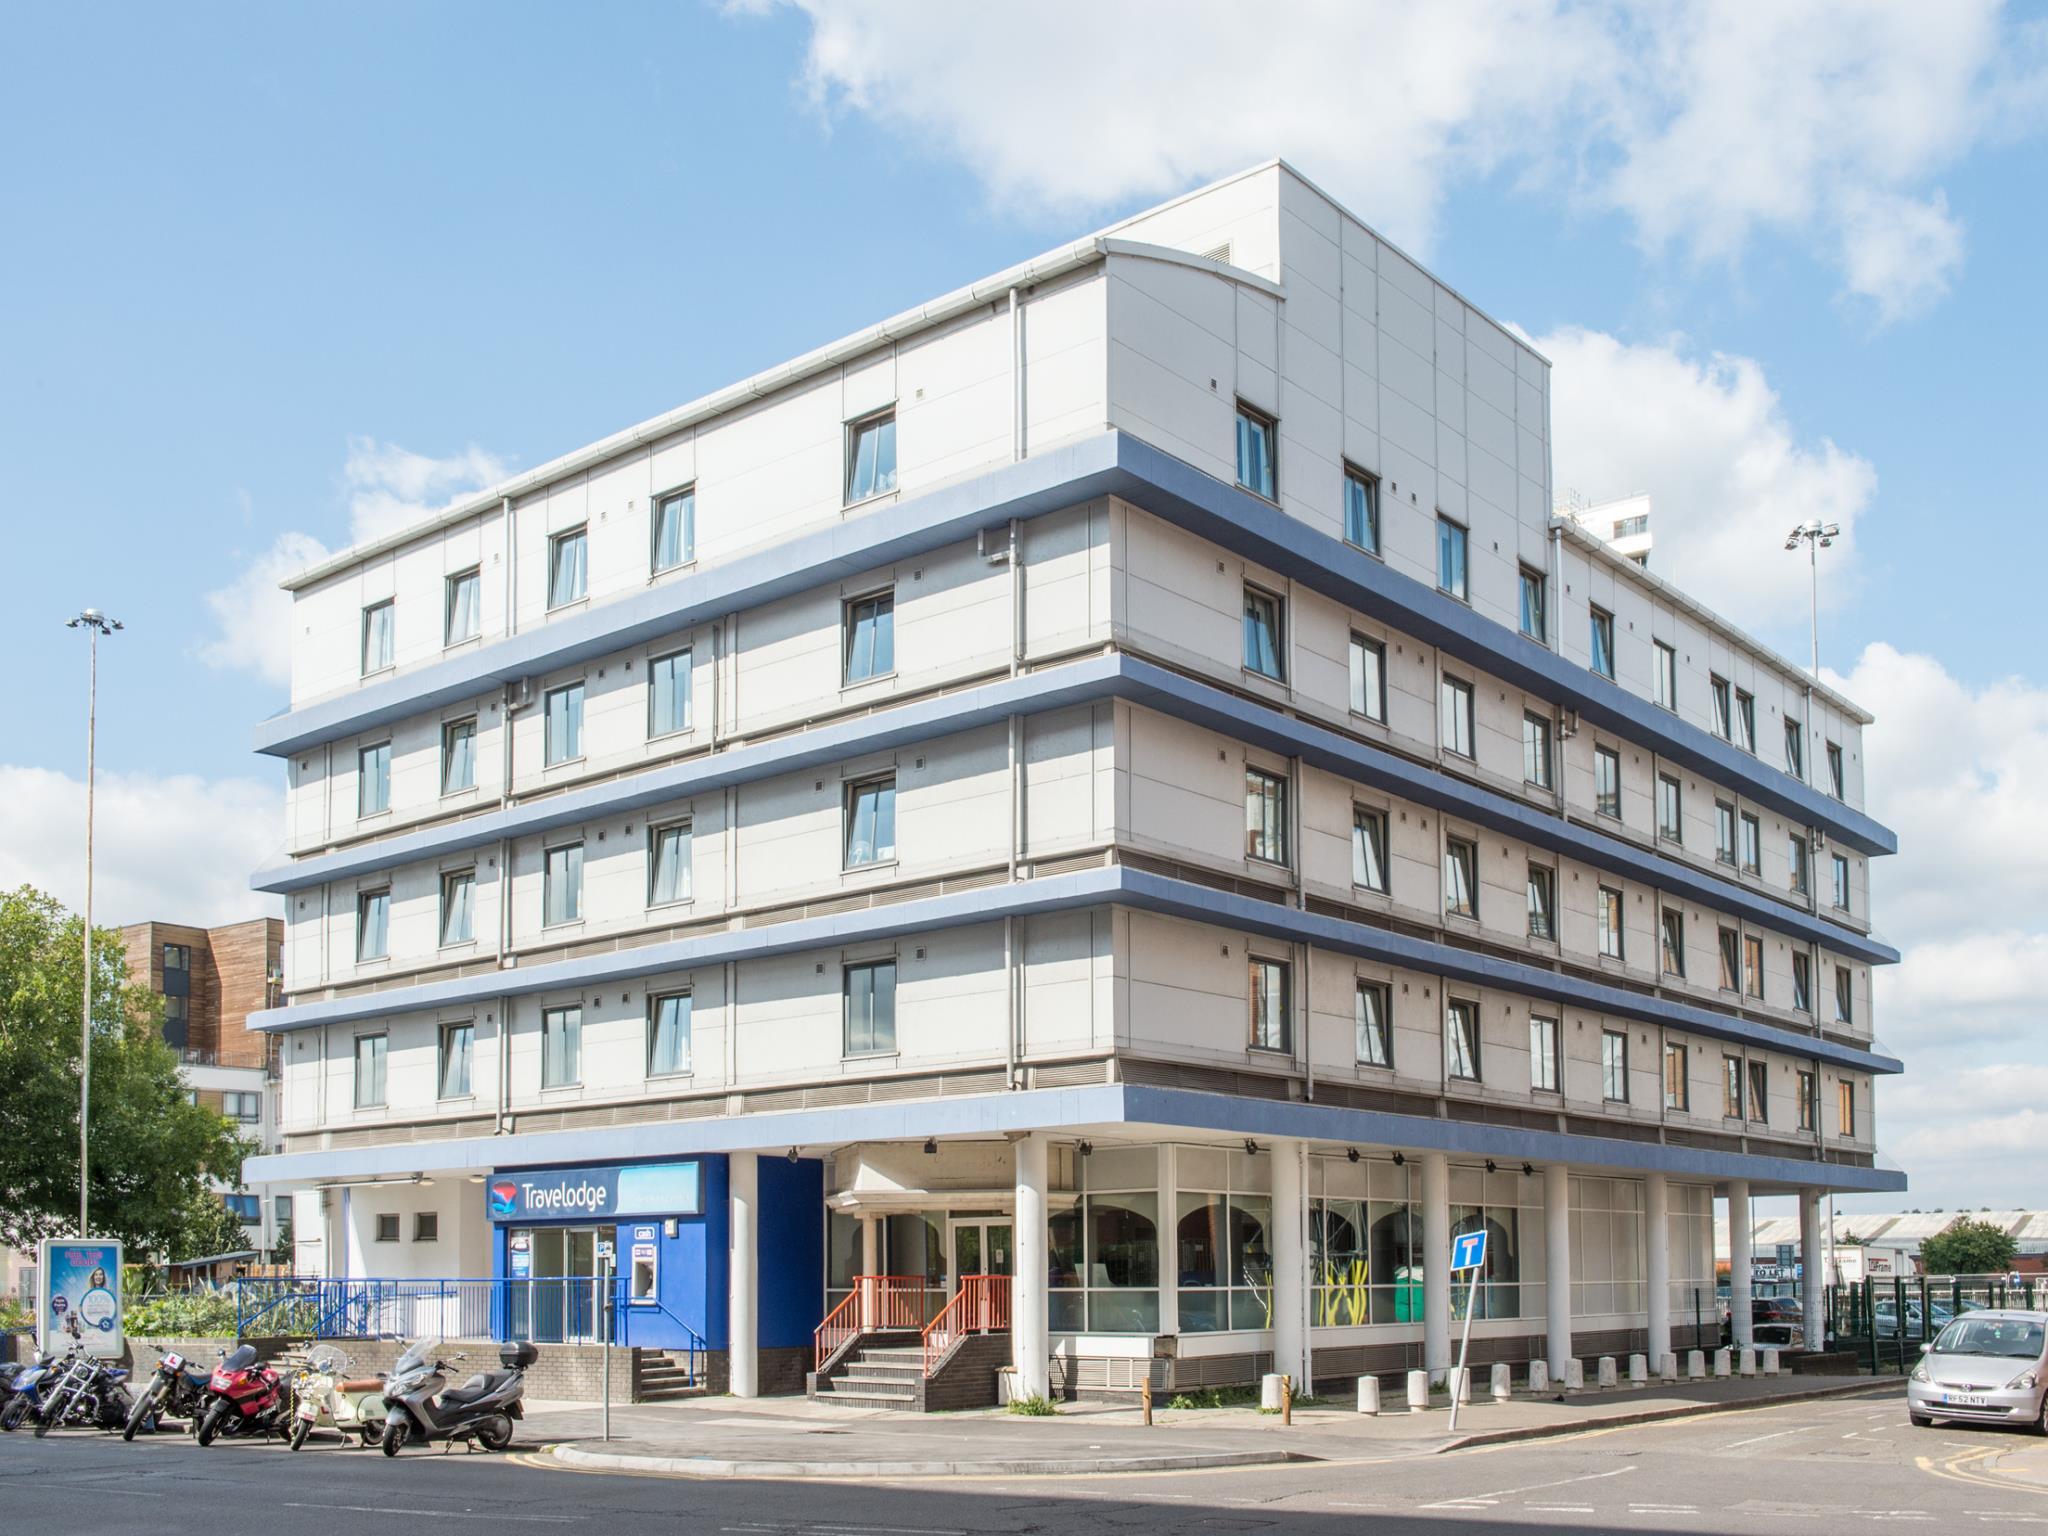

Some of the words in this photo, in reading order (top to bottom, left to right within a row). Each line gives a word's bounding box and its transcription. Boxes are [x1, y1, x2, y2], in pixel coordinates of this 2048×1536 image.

[522, 1181, 607, 1213] Travelodge
[1769, 1269, 1785, 1278] LET
[168, 1356, 177, 1364] L
